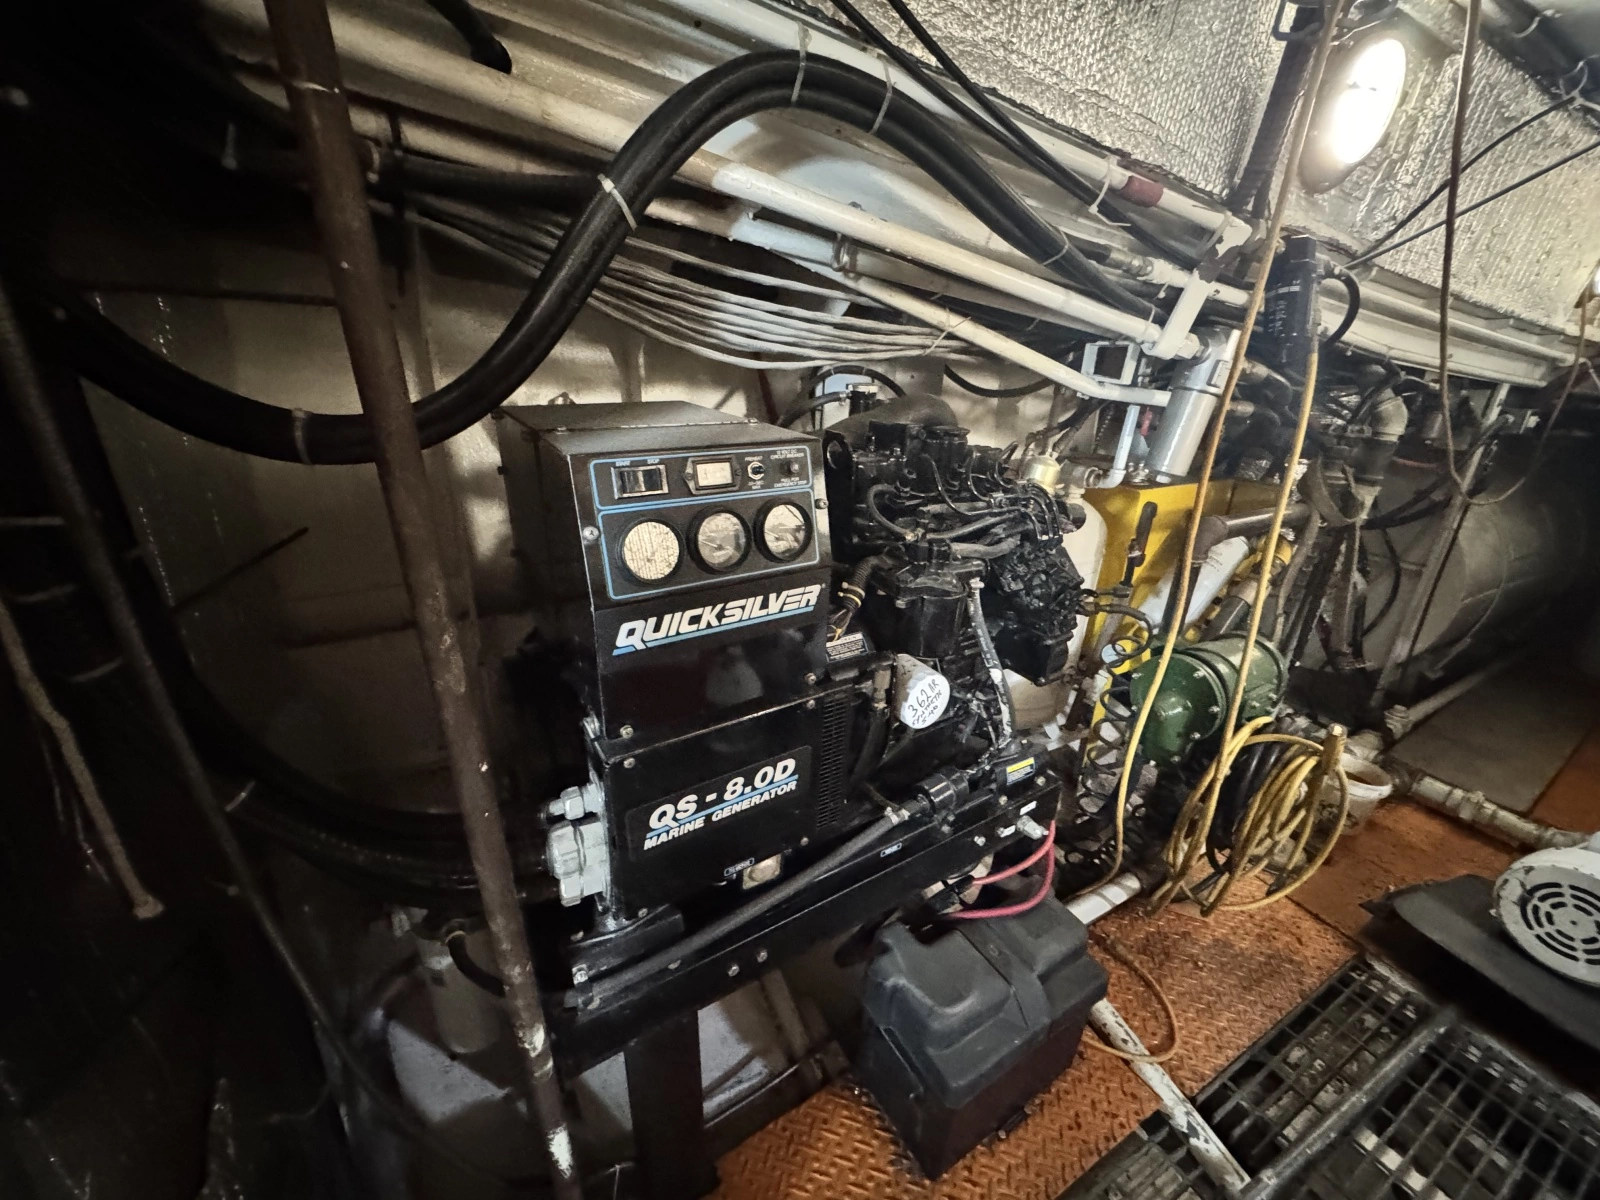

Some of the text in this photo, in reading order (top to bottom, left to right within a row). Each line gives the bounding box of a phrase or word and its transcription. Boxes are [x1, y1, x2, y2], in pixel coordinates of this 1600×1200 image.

[614, 584, 821, 651] QUICKSILVER
[643, 780, 797, 851] MARINE GENERATOR
[649, 794, 699, 830] QS
[723, 758, 796, 800] 8.0D
